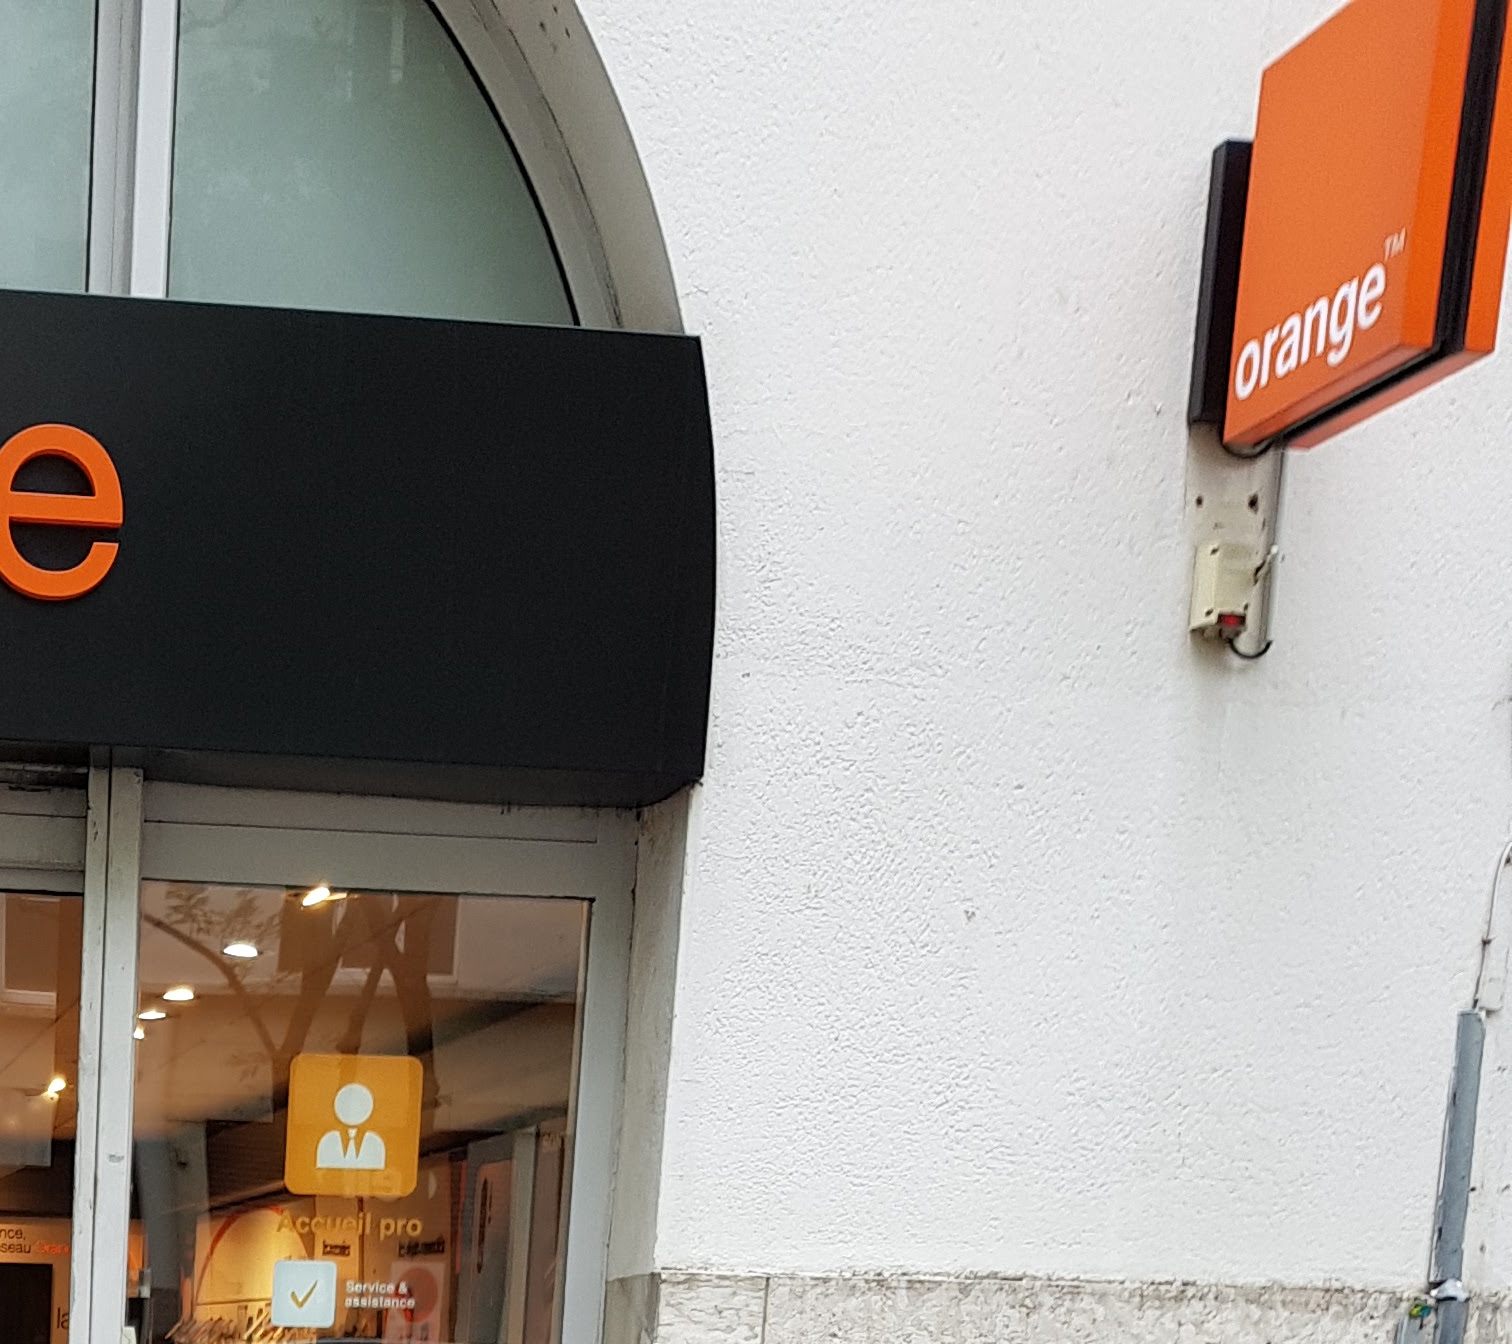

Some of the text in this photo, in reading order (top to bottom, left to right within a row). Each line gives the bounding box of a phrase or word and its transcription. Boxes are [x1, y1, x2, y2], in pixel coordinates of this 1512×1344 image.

[1234, 262, 1387, 401] orange
[277, 1208, 423, 1241] Accueil pro
[345, 1279, 408, 1293] Service &
[344, 1296, 416, 1309] assistance
